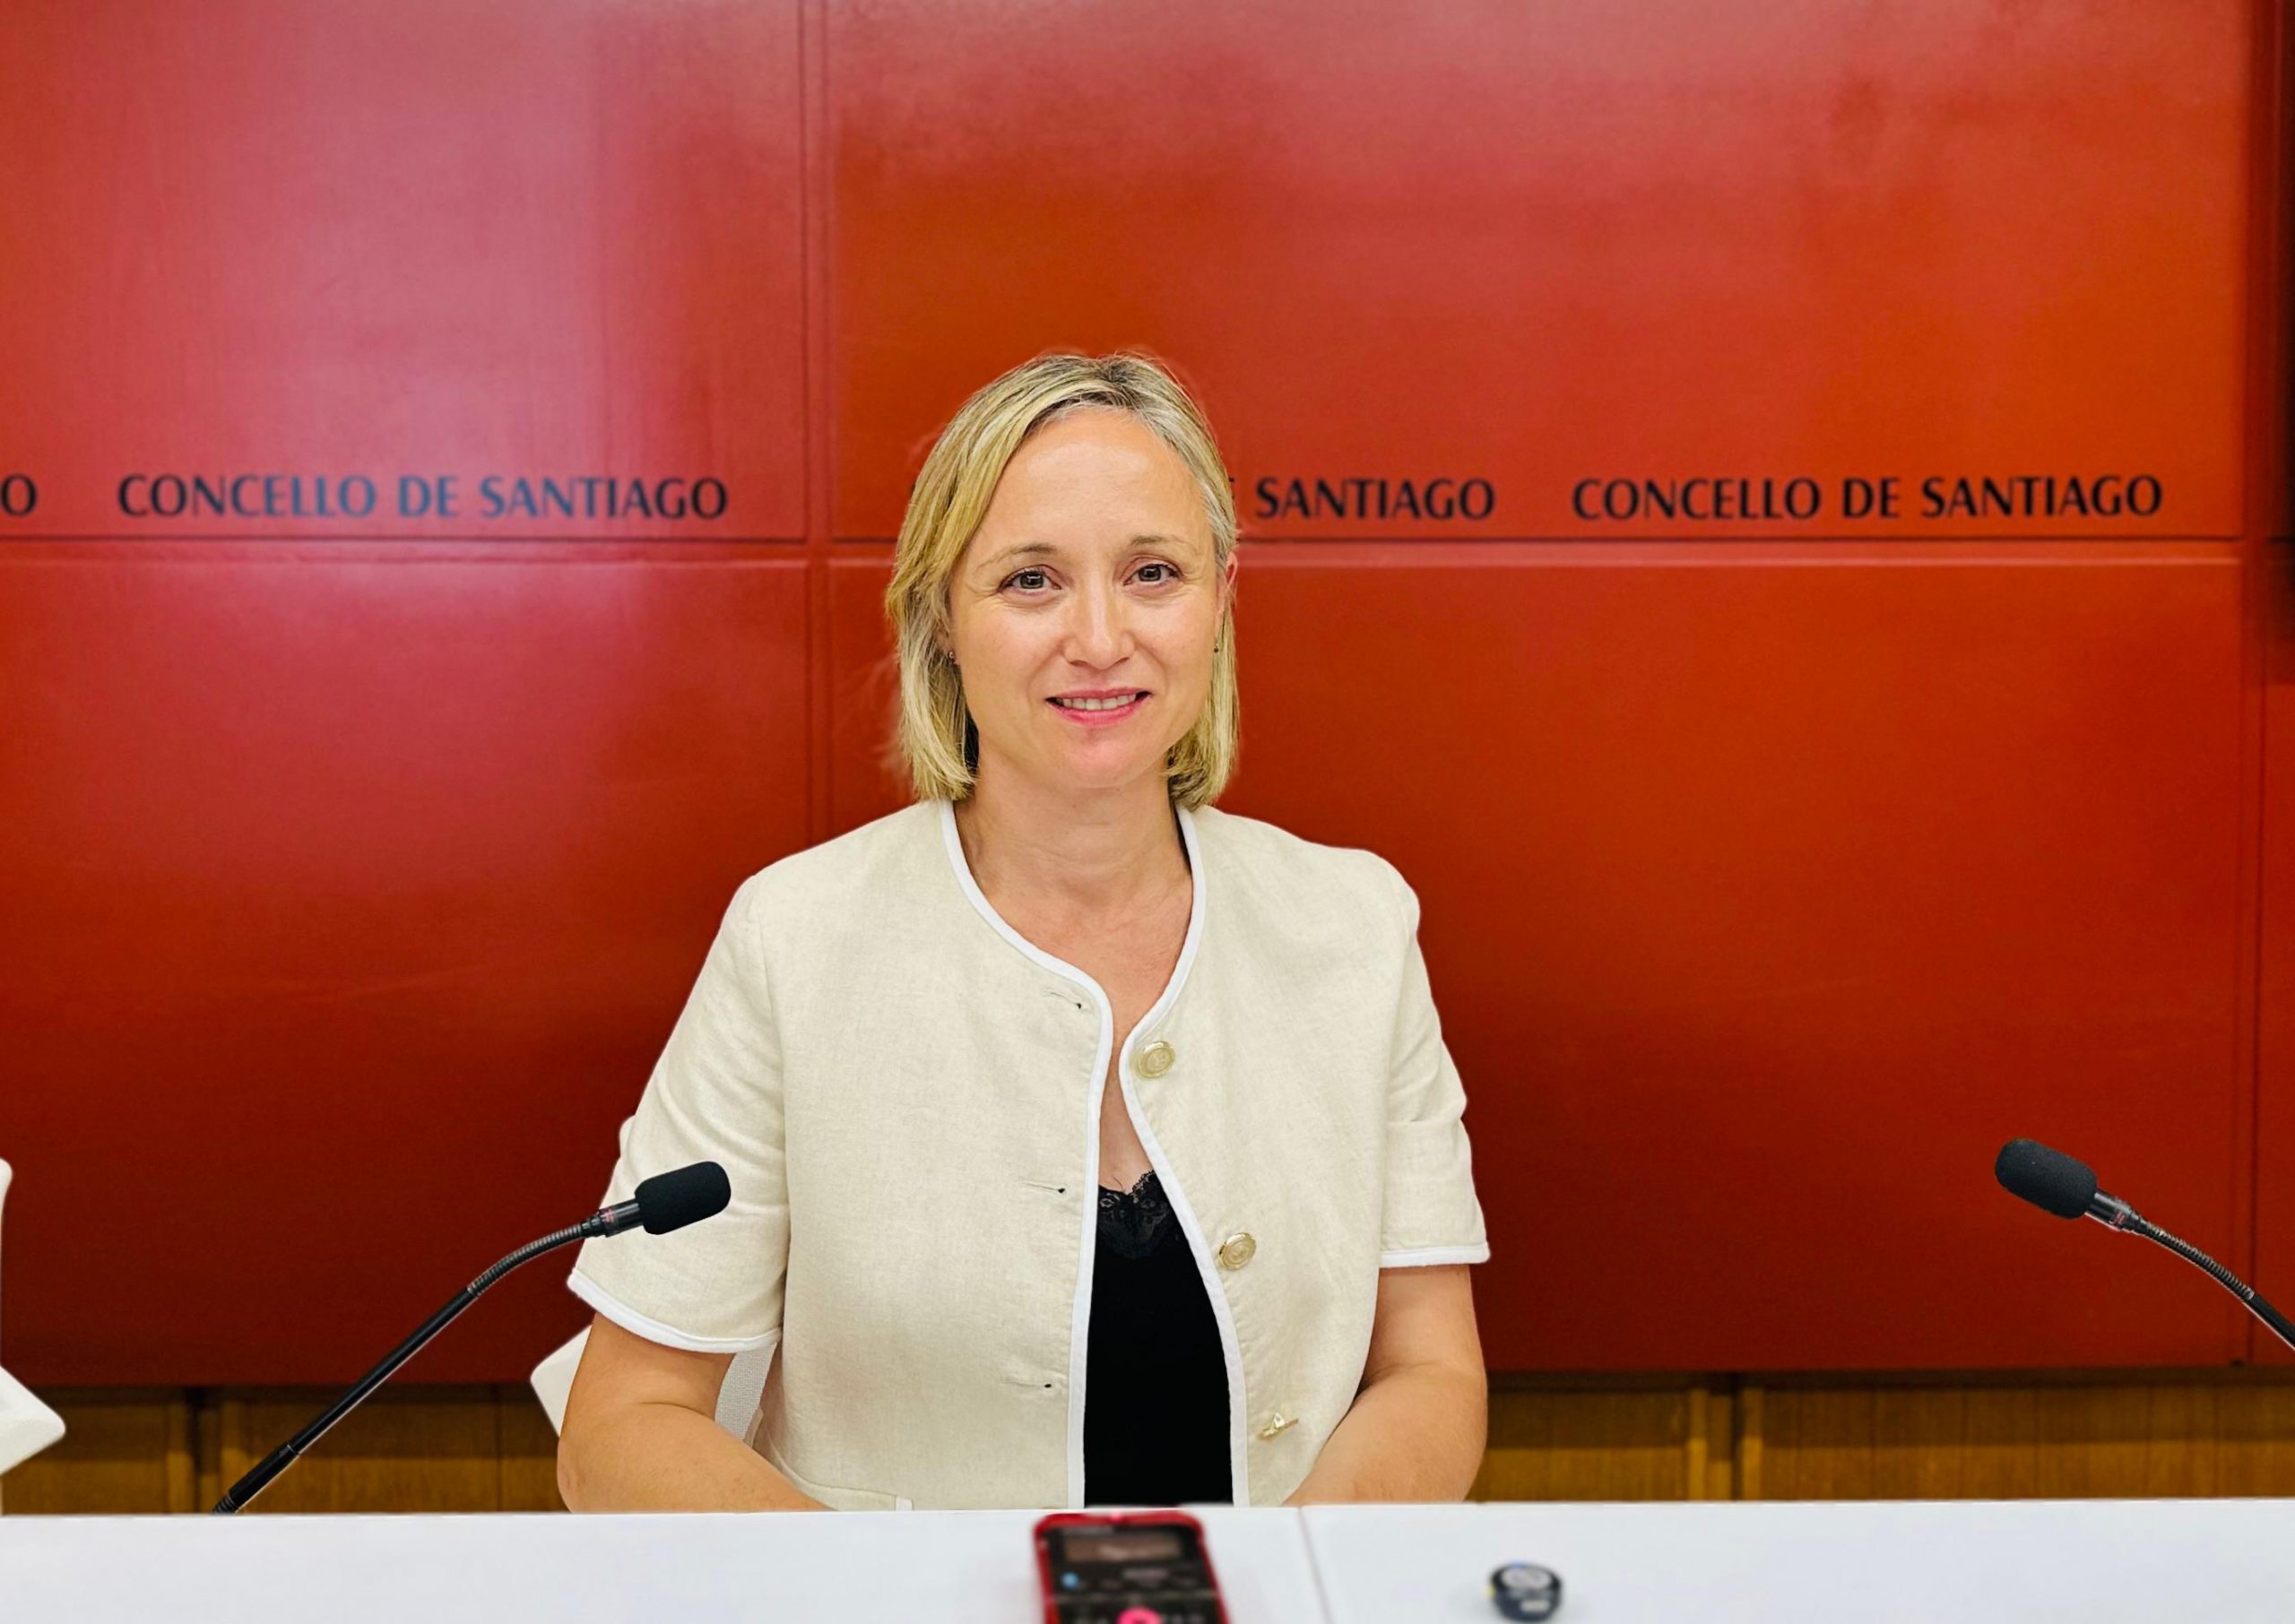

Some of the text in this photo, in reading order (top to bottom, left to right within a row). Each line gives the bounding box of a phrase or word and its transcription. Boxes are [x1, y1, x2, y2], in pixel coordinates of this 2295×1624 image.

[0, 473, 38, 516] O
[117, 473, 729, 522] CONCELLO DE SANTIAGO
[1256, 477, 1496, 520] SANTIAGO
[1572, 475, 2164, 520] CONCELLO DE SANTIAGO
